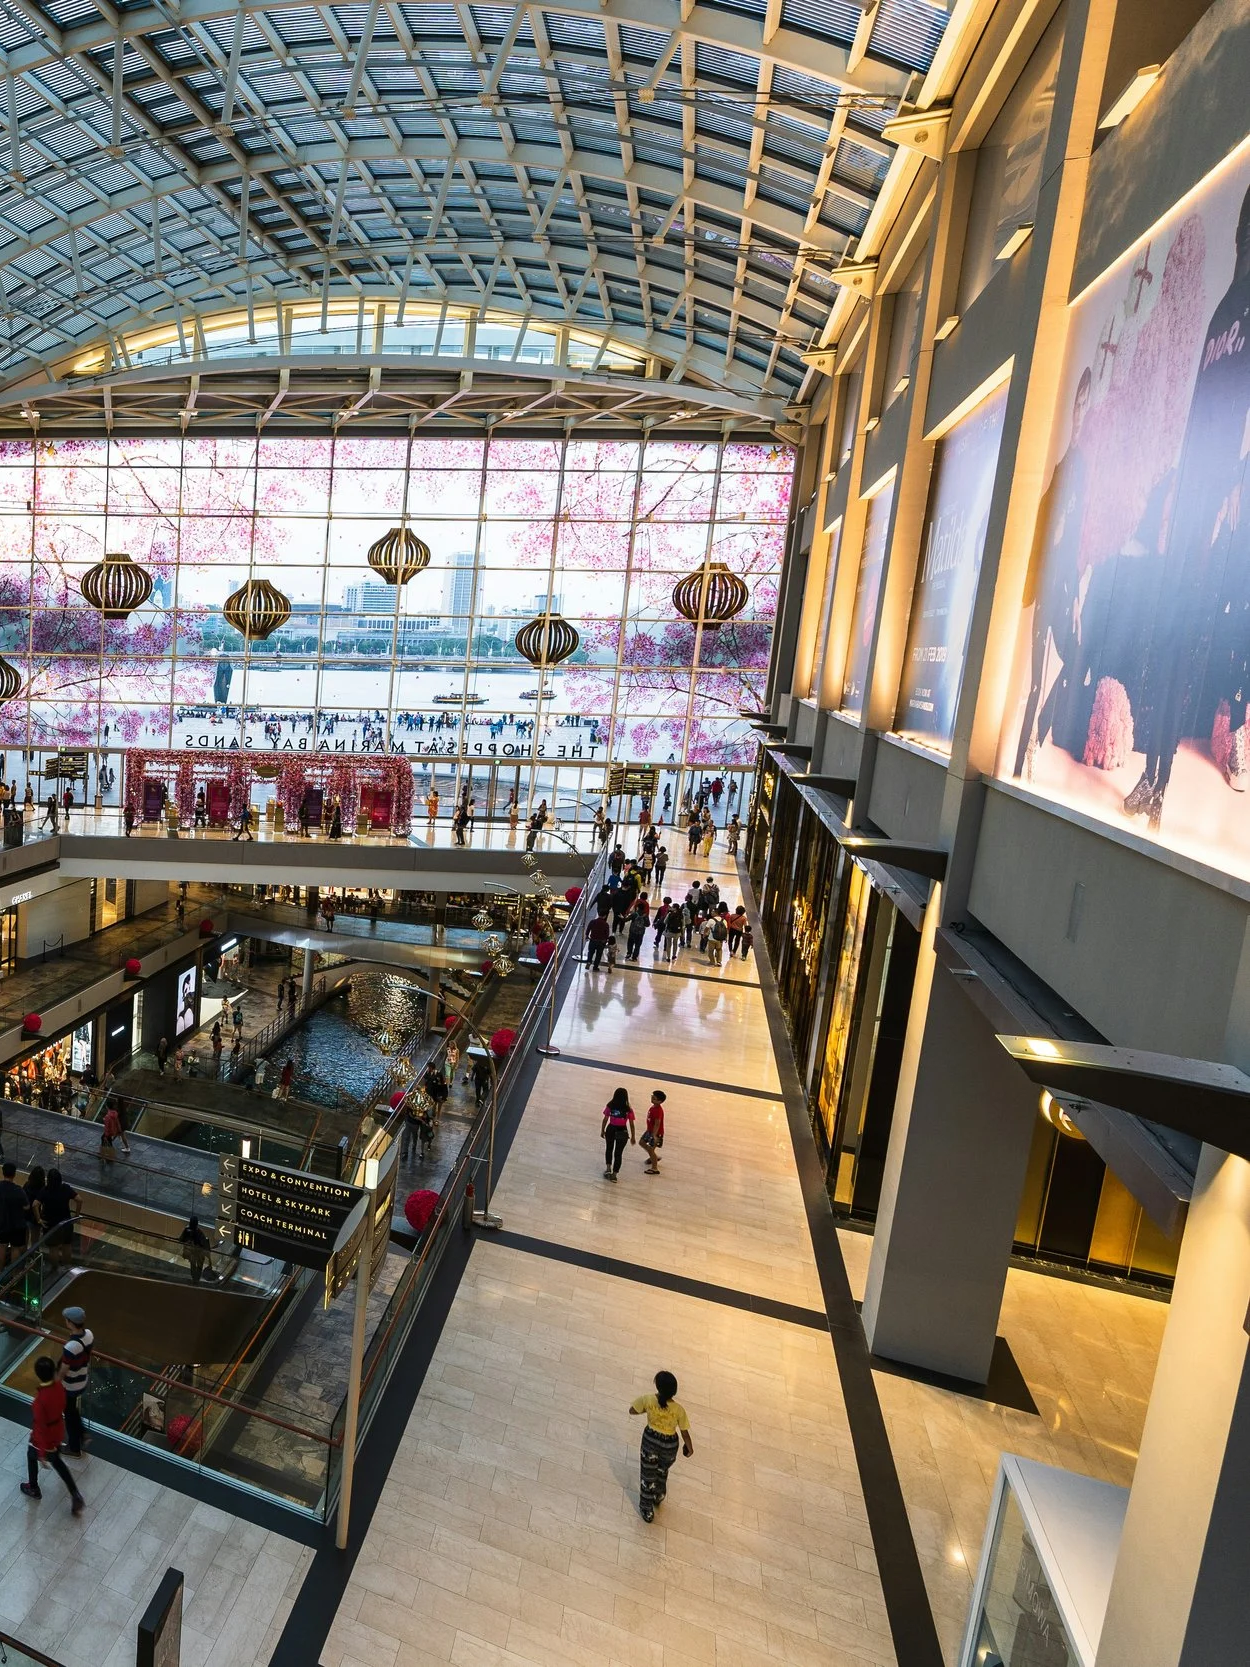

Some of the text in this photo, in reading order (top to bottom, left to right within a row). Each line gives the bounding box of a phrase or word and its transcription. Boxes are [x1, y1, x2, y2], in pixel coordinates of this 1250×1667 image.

[242, 1164, 267, 1177] EXPO
[270, 1171, 277, 1180] &
[280, 1175, 350, 1198] CONVENTION
[241, 1187, 272, 1202] HOTEL
[275, 1196, 282, 1204] &
[285, 1199, 331, 1217] SKYPARK
[240, 1208, 273, 1225] COACH
[275, 1219, 327, 1240] TERMINAL
